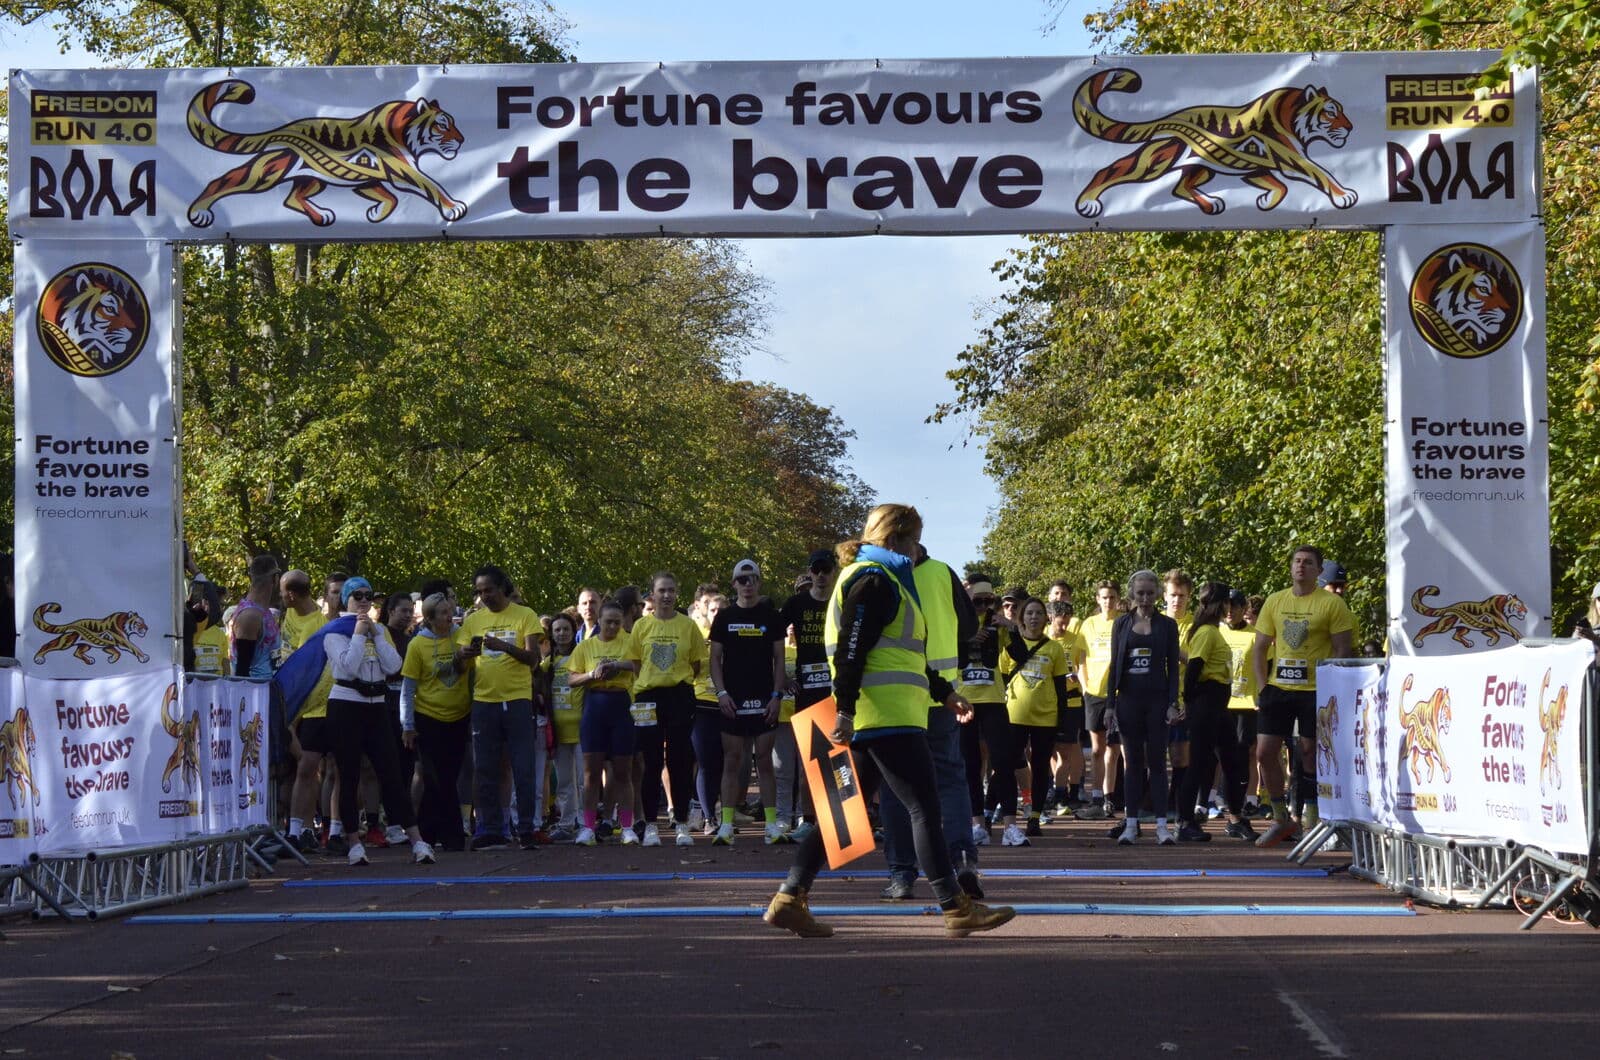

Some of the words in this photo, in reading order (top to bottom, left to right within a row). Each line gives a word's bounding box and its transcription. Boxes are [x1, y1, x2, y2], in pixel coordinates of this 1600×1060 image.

[1389, 78, 1511, 97] FREEDM
[34, 95, 153, 113] FREEDOM
[497, 86, 763, 129] Fortune
[785, 81, 1043, 126] favours
[1391, 106, 1453, 126] RUN
[1462, 103, 1510, 123] 4.0
[35, 123, 97, 141] RUN
[105, 122, 153, 142] 4.0
[497, 141, 690, 213] the
[733, 138, 1043, 211] brave
[1411, 417, 1525, 436] Fortune
[35, 434, 150, 454] Fortune
[1412, 439, 1525, 460] favours
[35, 457, 150, 478] favours
[1412, 463, 1452, 480] the
[1460, 463, 1525, 480] brave
[35, 481, 76, 498] the
[85, 482, 150, 498] brave
[1413, 488, 1525, 501] freedomrun.uk
[35, 506, 149, 519] freedomrun.uk
[806, 673, 830, 682] 429
[1280, 669, 1303, 678] 493
[742, 699, 762, 708] 419
[56, 700, 130, 730] Fortune
[61, 736, 135, 768] favours
[1482, 754, 1510, 783] the
